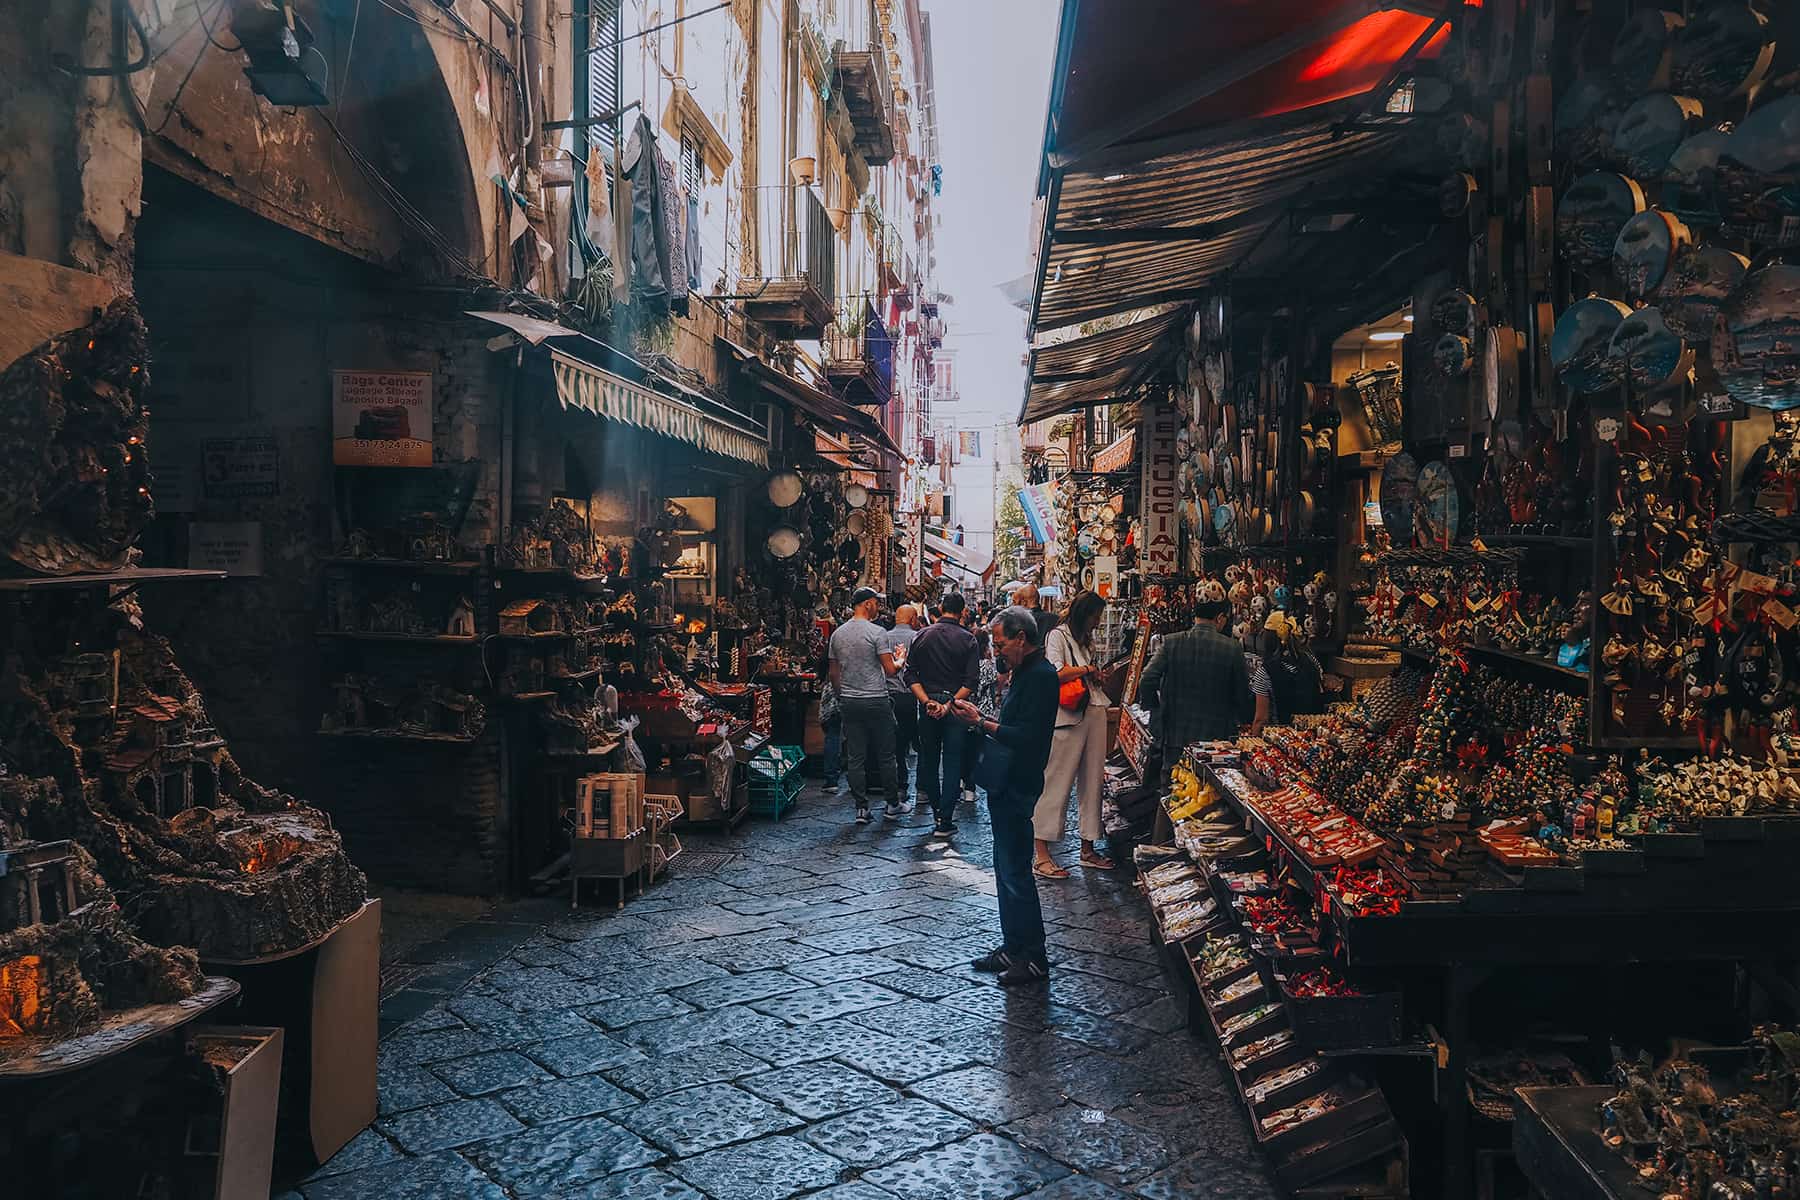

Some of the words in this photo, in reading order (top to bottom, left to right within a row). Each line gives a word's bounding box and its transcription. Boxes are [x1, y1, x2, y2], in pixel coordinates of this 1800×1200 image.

[343, 375, 374, 387] Bags
[379, 376, 424, 387] Center
[343, 386, 383, 396] Luggage
[385, 387, 423, 397] Storage
[343, 396, 385, 405] Deposito
[387, 397, 424, 408] Bagagli
[388, 440, 401, 449] 24
